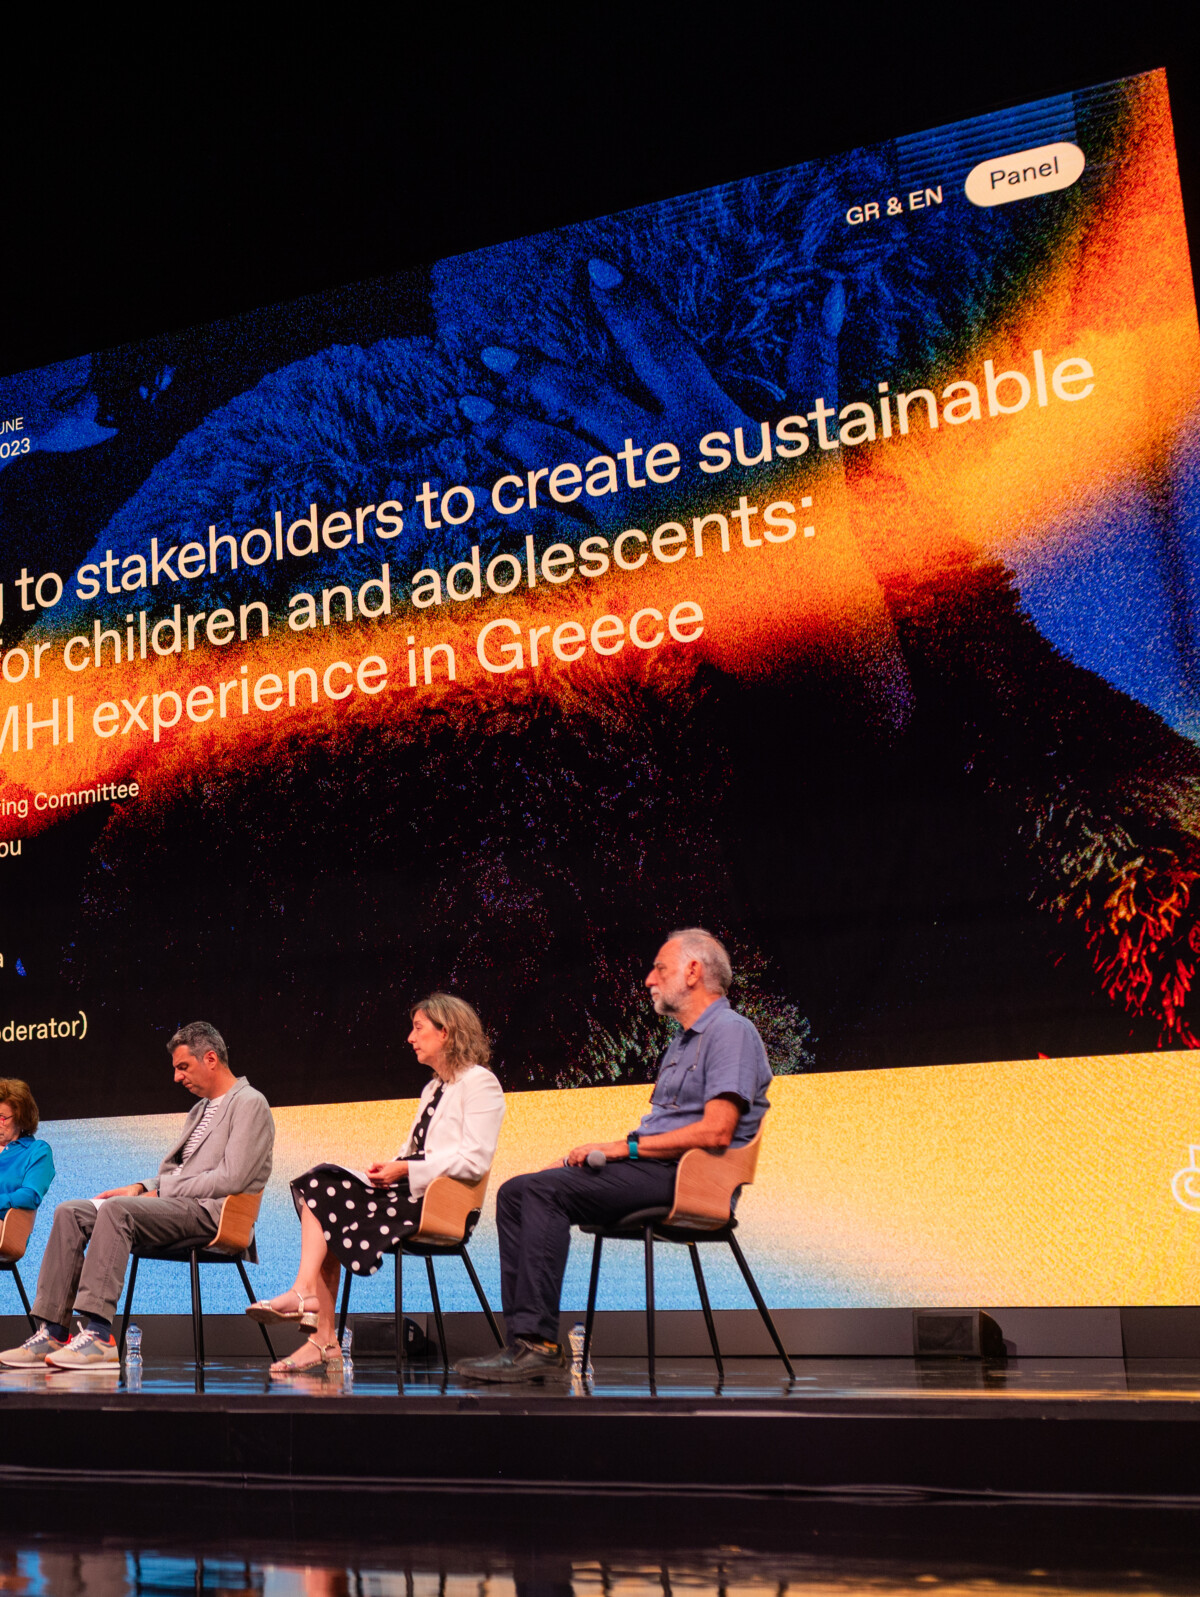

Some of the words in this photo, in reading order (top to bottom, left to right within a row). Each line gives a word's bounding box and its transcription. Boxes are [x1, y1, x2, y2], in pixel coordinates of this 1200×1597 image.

[846, 202, 880, 225] GR
[886, 196, 903, 216] &
[909, 185, 943, 211] EN
[990, 155, 1059, 190] Panel
[14, 567, 63, 612] to
[75, 500, 404, 600] stakeholders
[415, 481, 475, 530] to
[491, 438, 681, 515] create
[698, 348, 1096, 474] sustainable
[63, 601, 270, 675] children
[288, 562, 392, 632] and
[411, 495, 816, 609] adolescents:
[92, 654, 388, 744] experience
[406, 635, 456, 688] in
[476, 600, 705, 674] Greece
[34, 782, 140, 811] Committee
